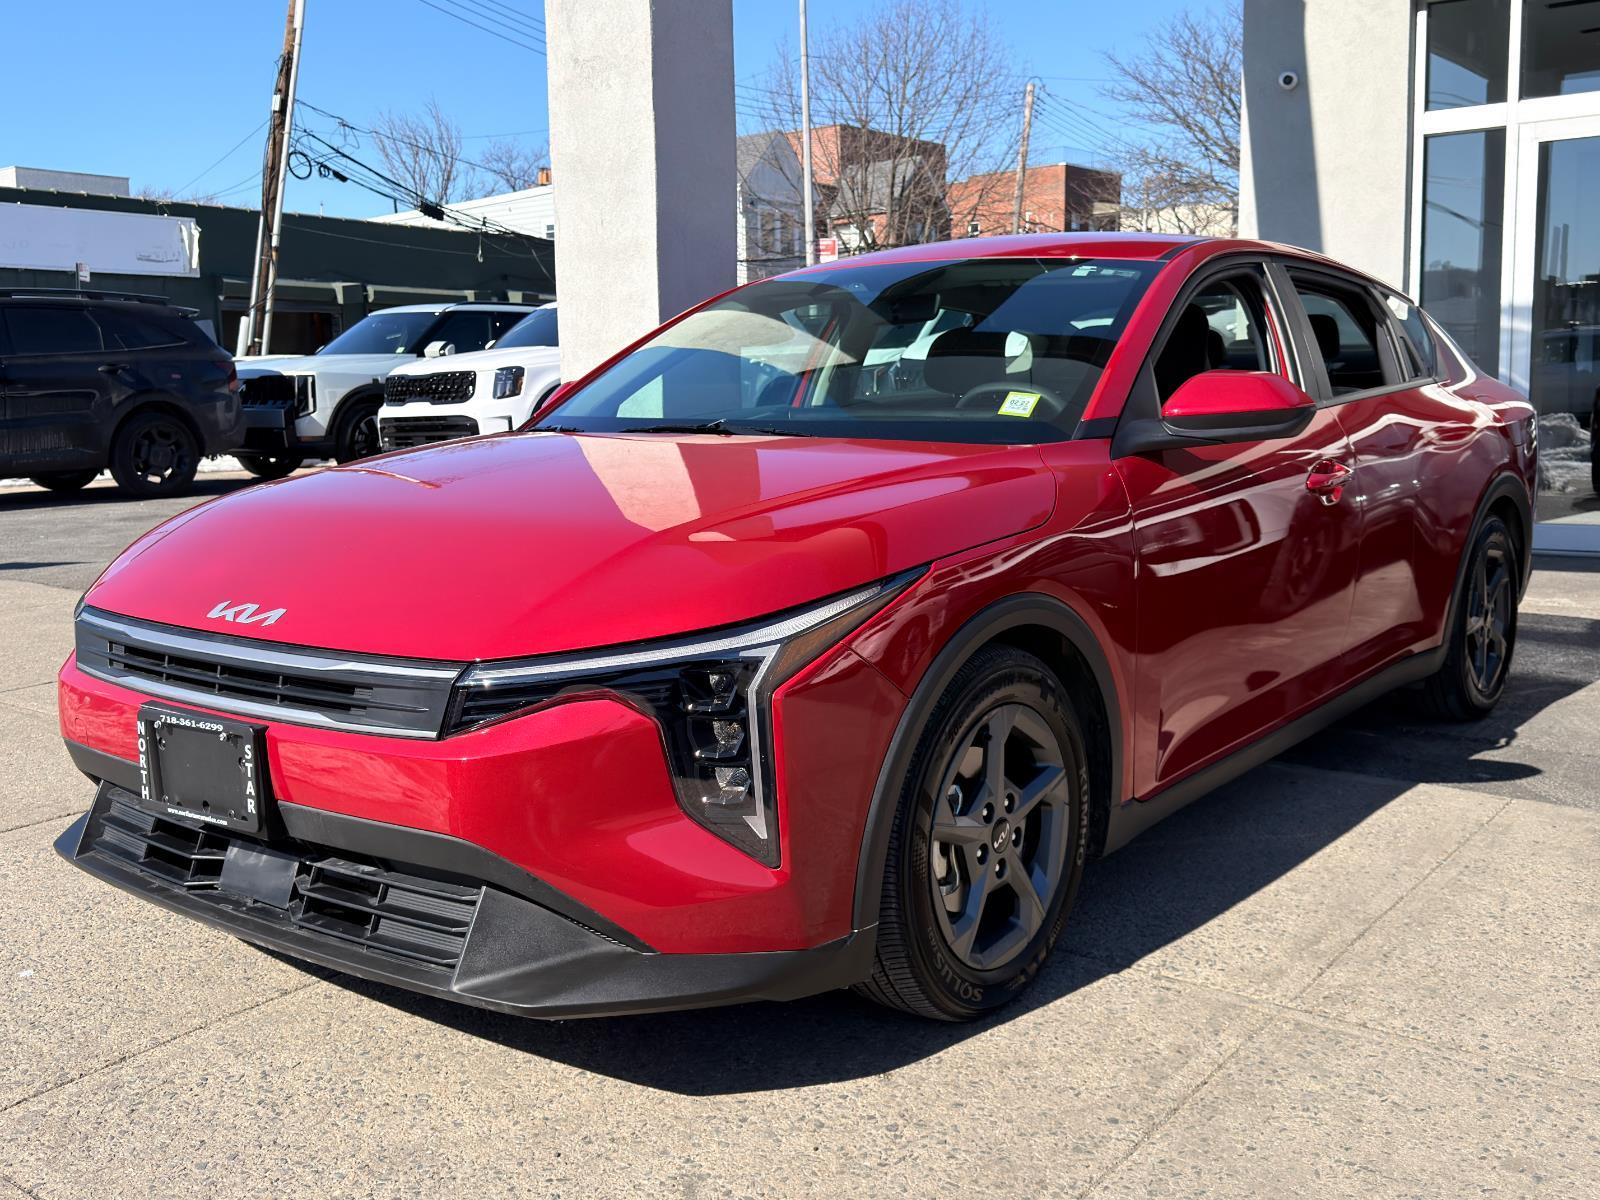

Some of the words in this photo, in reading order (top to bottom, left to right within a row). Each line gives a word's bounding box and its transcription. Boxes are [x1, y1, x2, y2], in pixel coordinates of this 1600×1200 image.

[160, 714, 223, 732] 718-361-6299
[137, 721, 149, 800] NORTH
[244, 744, 256, 814] STAR
[1076, 767, 1088, 866] KUMHO
[934, 952, 984, 1002] SOLUS
